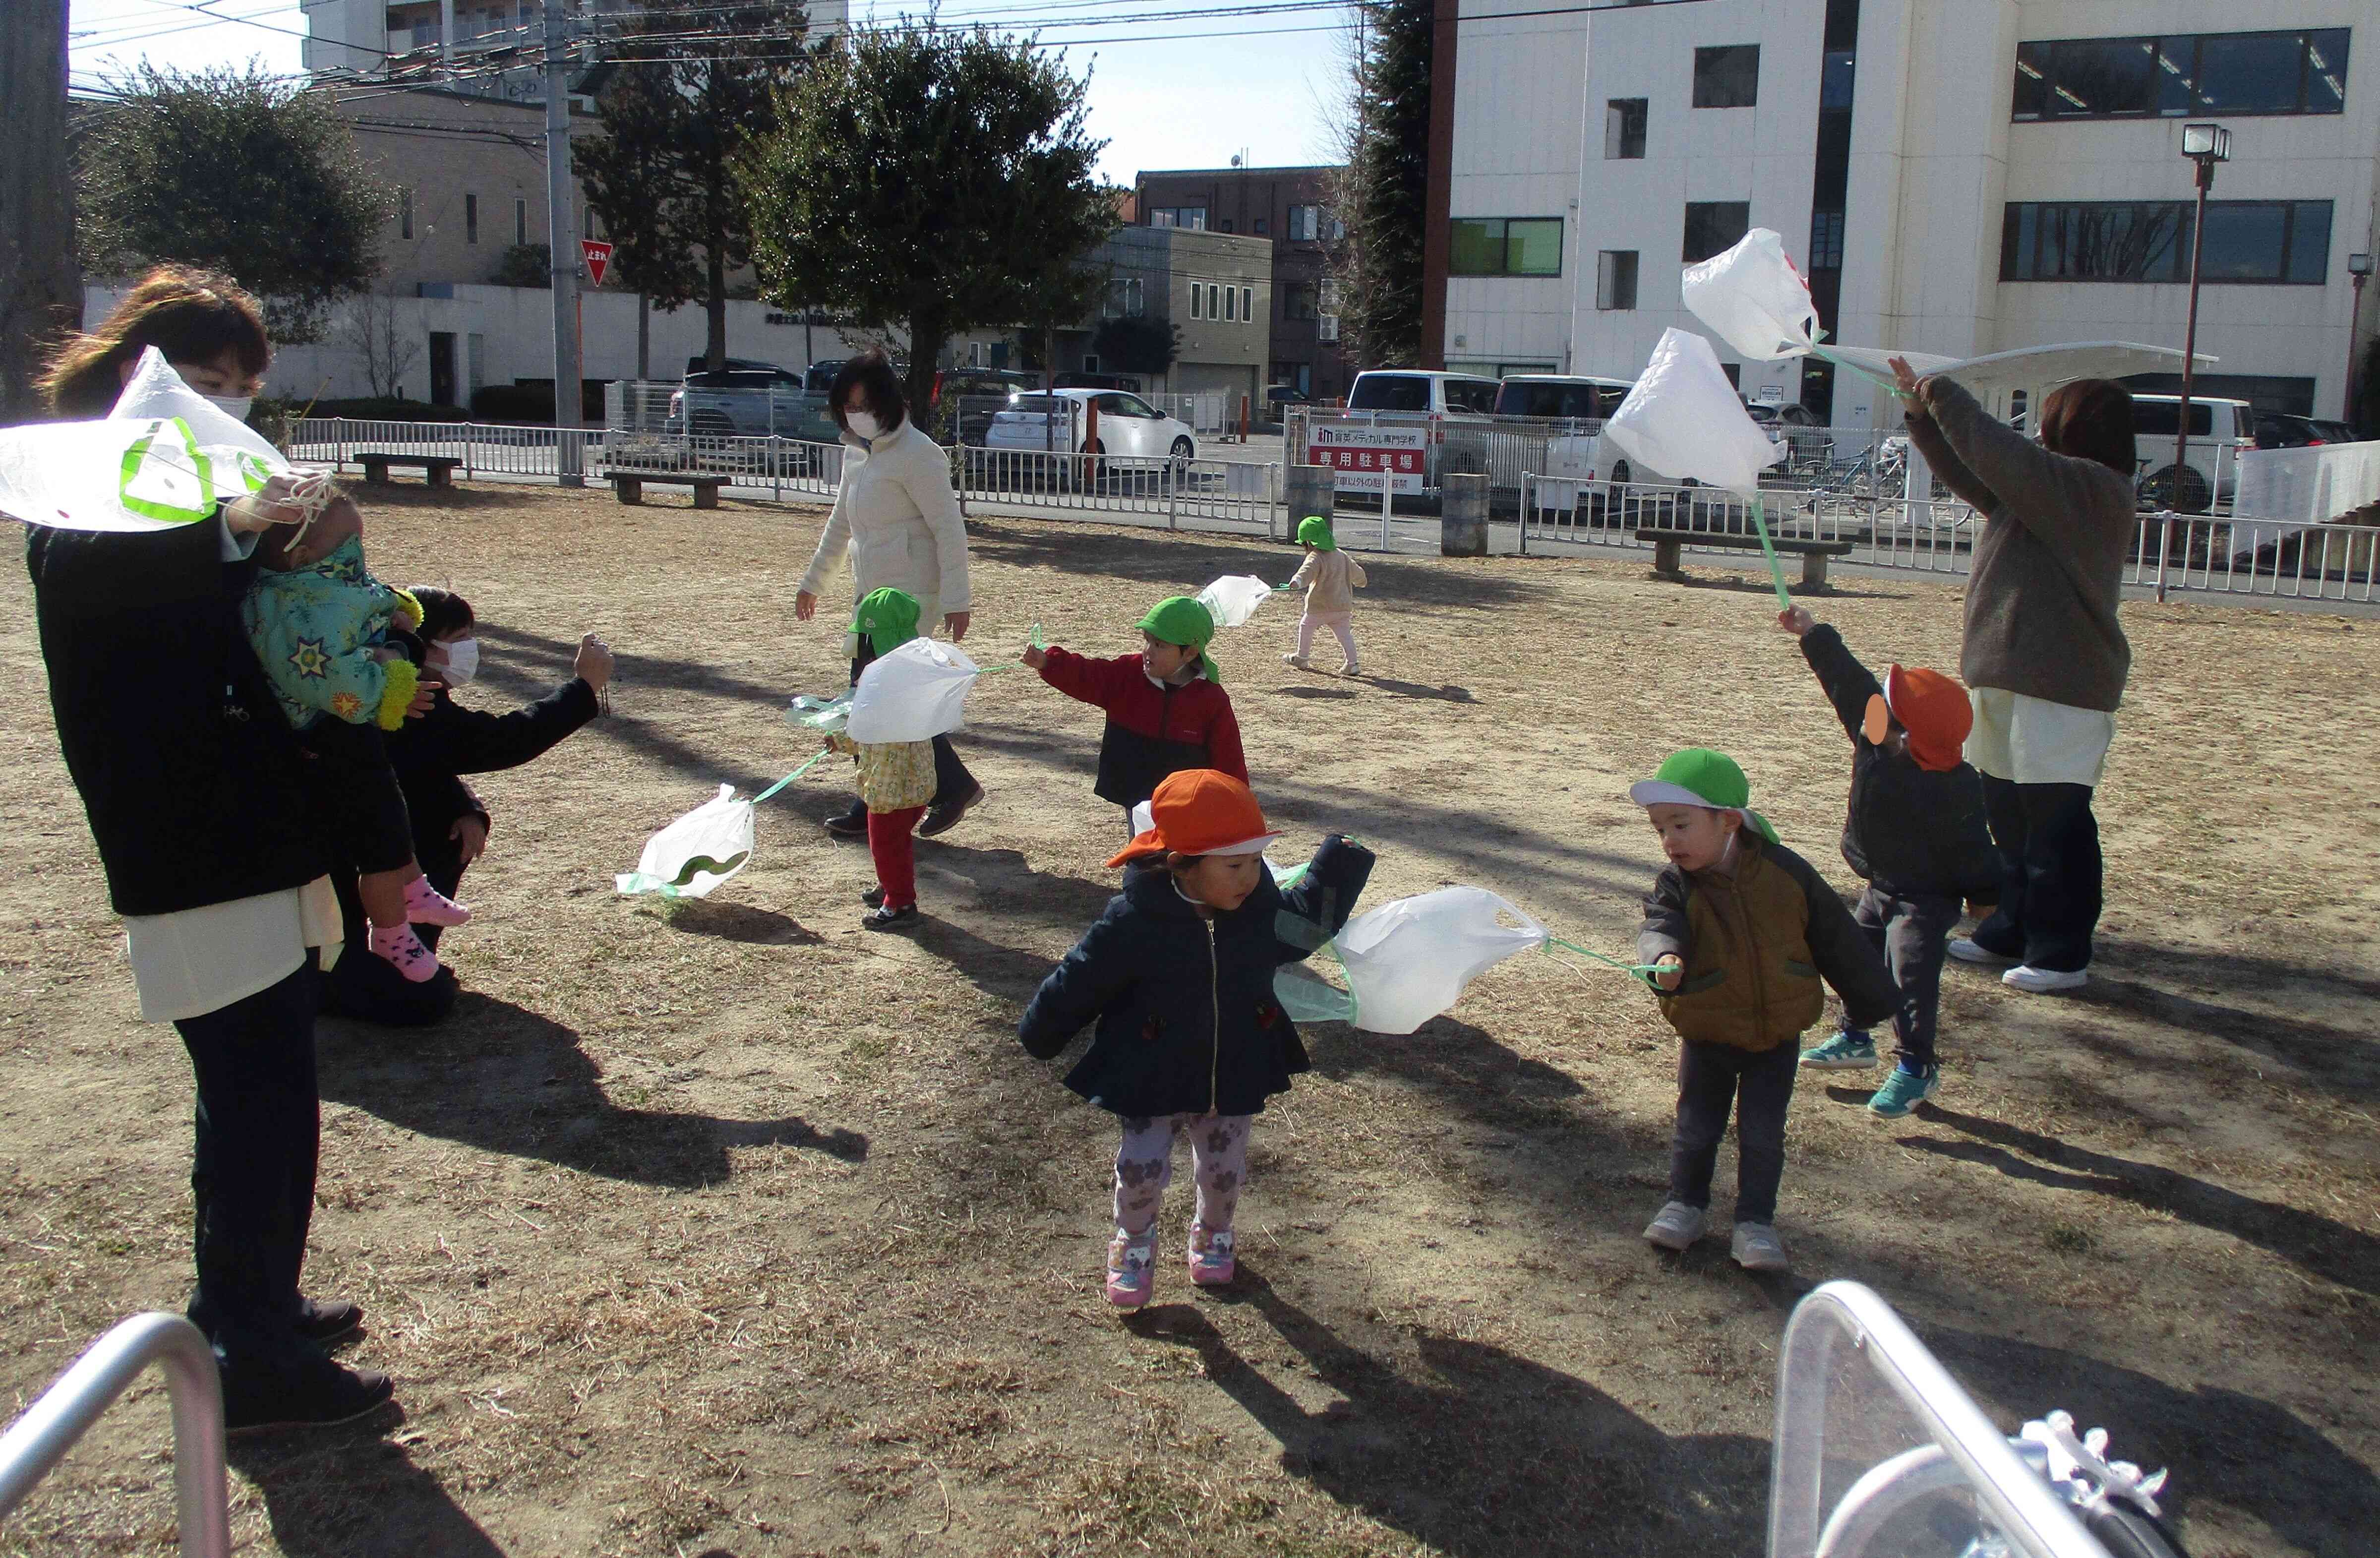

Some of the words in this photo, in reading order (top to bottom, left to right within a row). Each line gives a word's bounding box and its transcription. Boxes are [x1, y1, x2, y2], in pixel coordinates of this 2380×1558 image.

[588, 249, 606, 261] 止まれ
[1319, 451, 1413, 469] 専用駐車場
